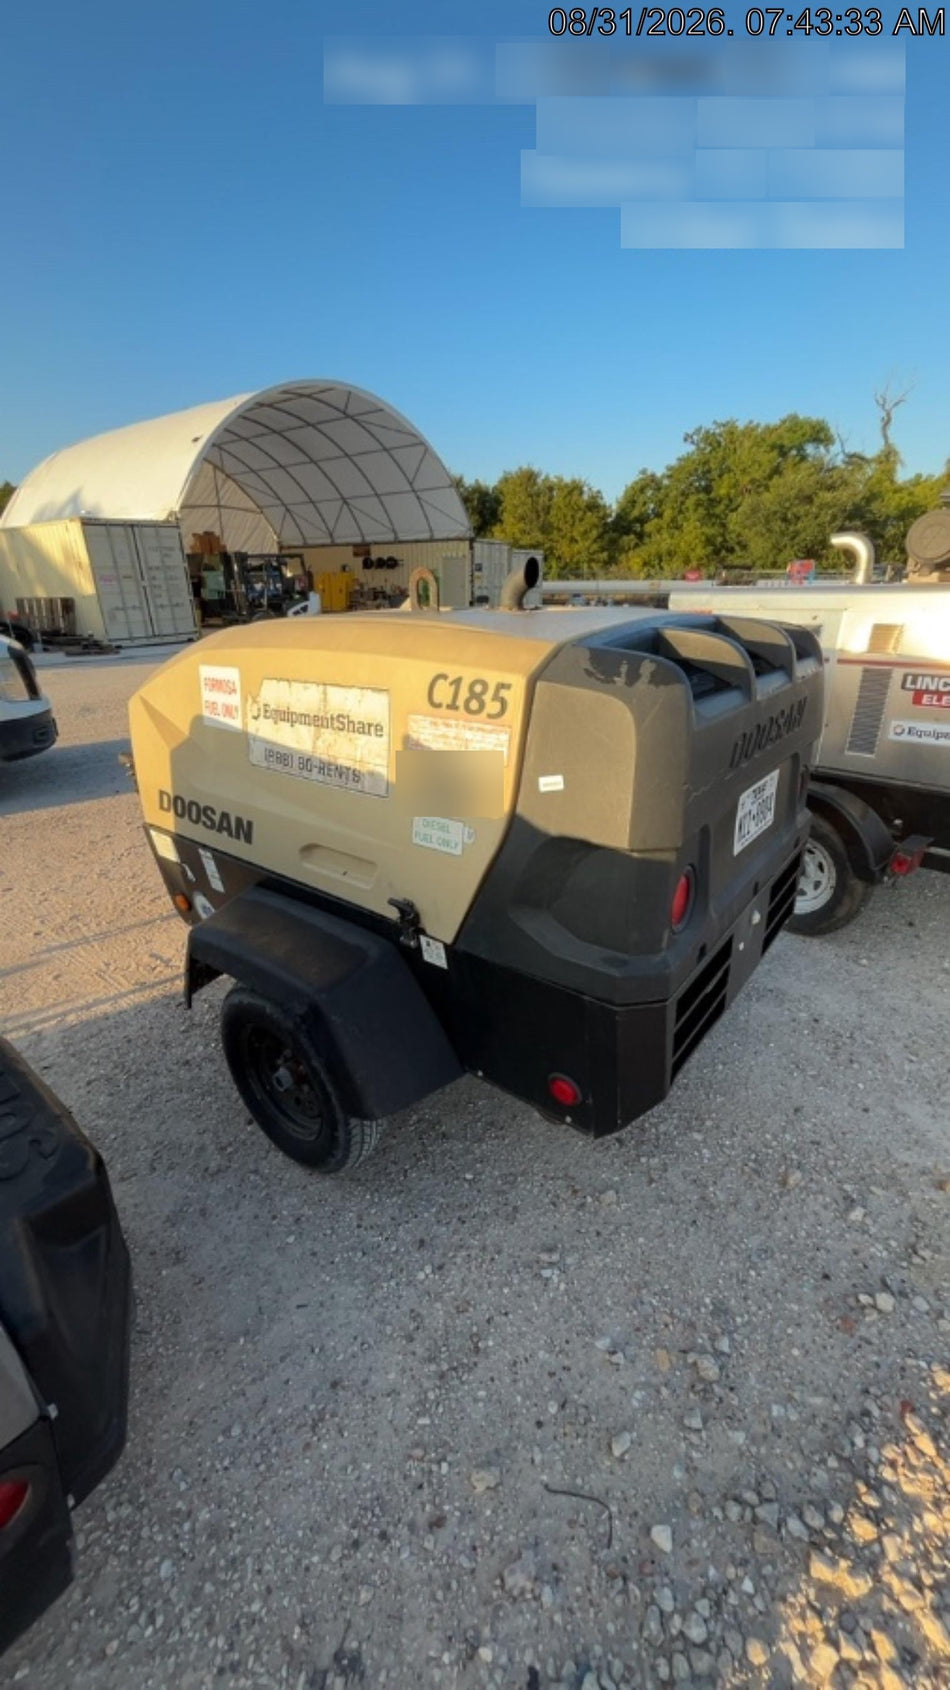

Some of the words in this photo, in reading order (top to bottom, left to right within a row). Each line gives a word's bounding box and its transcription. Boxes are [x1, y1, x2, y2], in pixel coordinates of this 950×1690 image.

[204, 676, 238, 695] FORMOSA
[427, 673, 512, 719] C185
[204, 700, 221, 717] FUEL
[221, 703, 239, 720] ONLY
[262, 703, 384, 738] EquipmentShare
[729, 697, 807, 769] DOOSAN
[158, 789, 254, 846] DOOSAN
[421, 818, 452, 835] DIESEL
[415, 830, 434, 845] FUEL
[436, 836, 459, 850] ONLY
